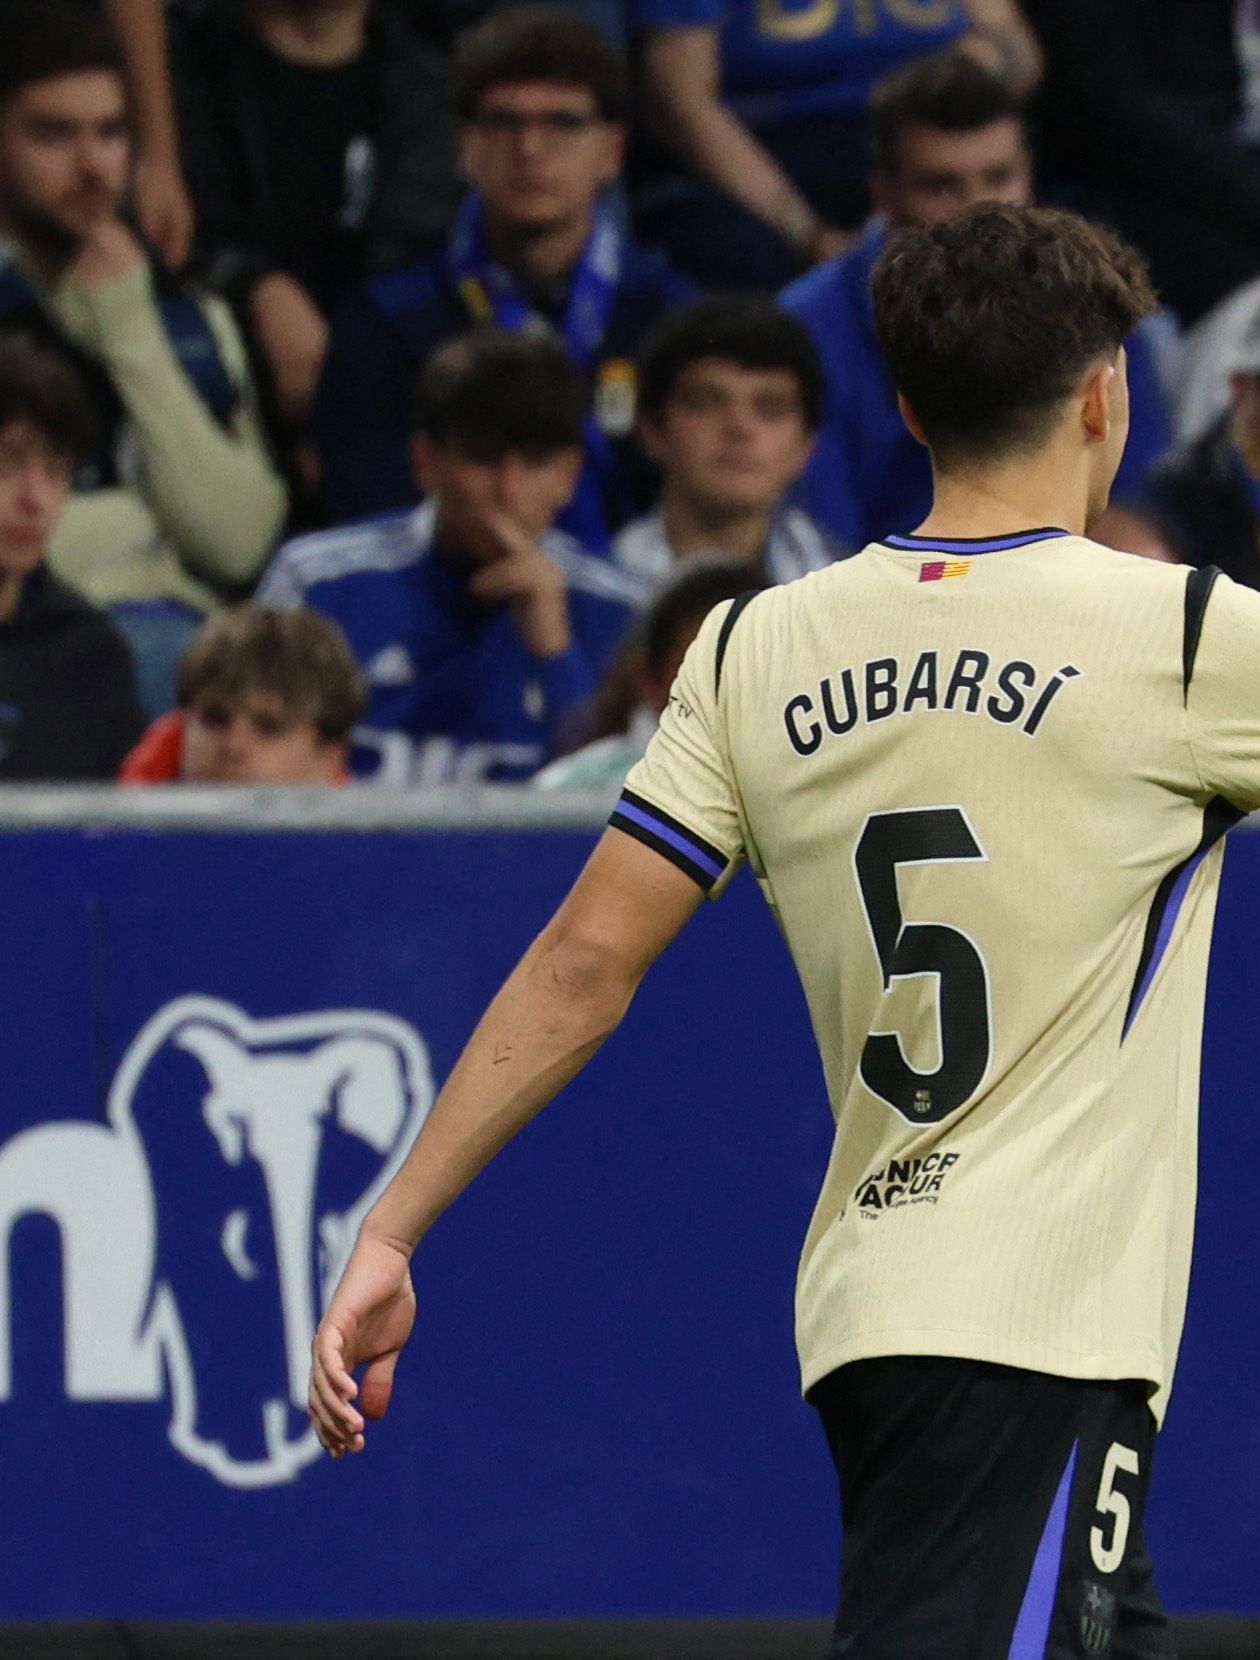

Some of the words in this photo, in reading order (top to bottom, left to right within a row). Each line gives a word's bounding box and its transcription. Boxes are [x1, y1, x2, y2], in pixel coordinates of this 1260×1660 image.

[783, 648, 1083, 757] CUBARSÍ
[852, 804, 989, 1127] 5
[1090, 1441, 1139, 1574] 5
